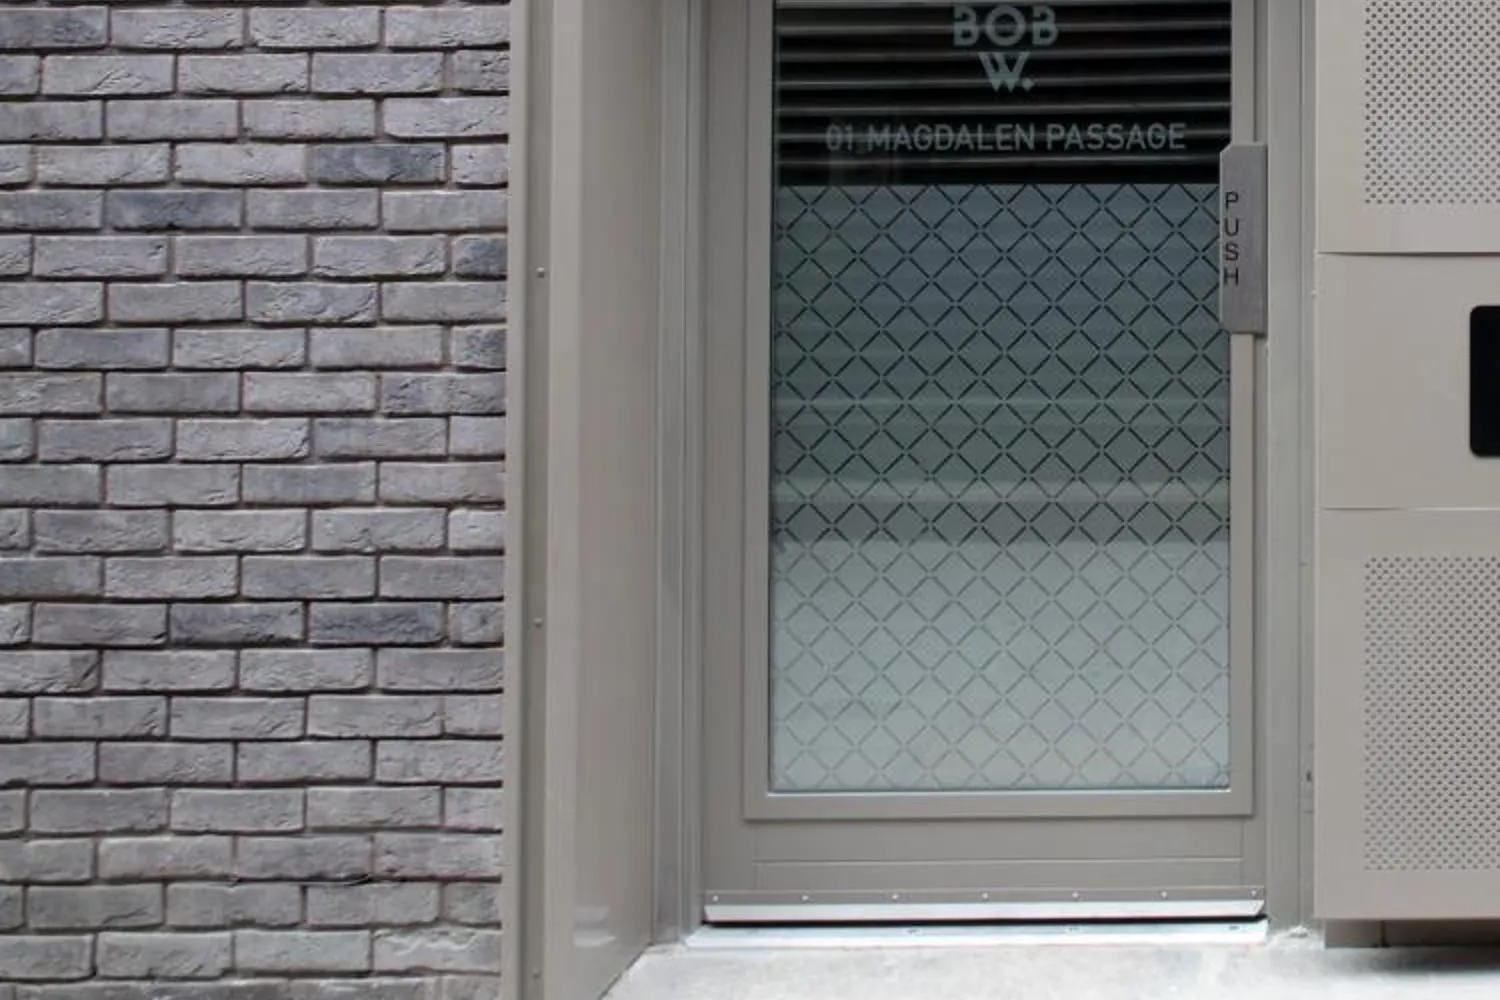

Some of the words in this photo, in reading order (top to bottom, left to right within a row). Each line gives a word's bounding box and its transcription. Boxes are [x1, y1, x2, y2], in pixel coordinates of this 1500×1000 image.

[953, 4, 1059, 47] BOB
[978, 51, 1036, 92] W.
[826, 124, 853, 152] 01
[867, 124, 1036, 152] MAGDALEN
[1046, 122, 1187, 150] PASSAGE
[1223, 191, 1240, 287] PUSH
